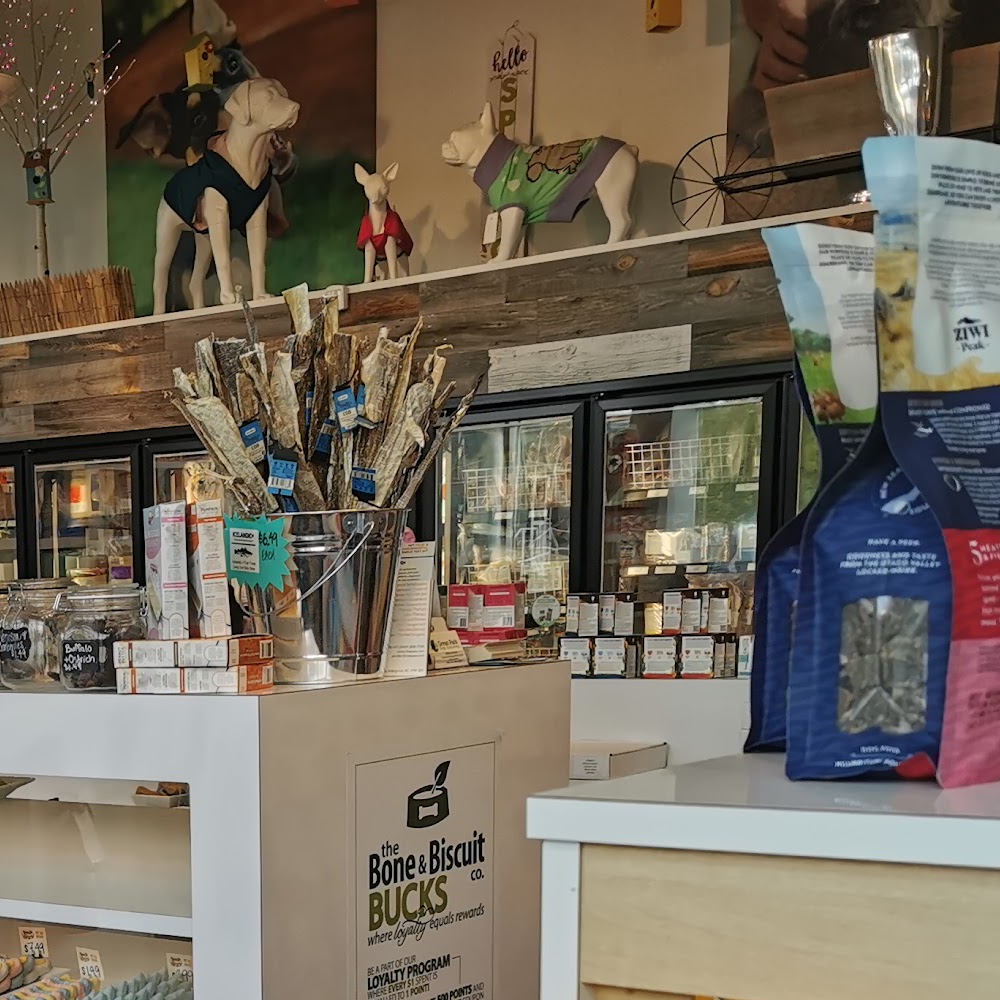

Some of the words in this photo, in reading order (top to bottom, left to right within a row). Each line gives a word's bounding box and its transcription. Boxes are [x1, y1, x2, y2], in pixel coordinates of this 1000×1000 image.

[492, 45, 529, 72] hello
[953, 324, 989, 342] ZIWI
[65, 643, 92, 653] Buffalo
[369, 853, 415, 889] Bone
[419, 854, 426, 874] &
[429, 830, 485, 875] Biscuit
[381, 841, 399, 857] the
[369, 875, 447, 931] BUCKS
[367, 930, 392, 946] where
[394, 913, 431, 946] loyalty
[429, 911, 454, 930] equals
[455, 902, 485, 922] rewards
[367, 967, 374, 976] BE
[380, 961, 394, 972] PART
[395, 958, 403, 967] OF
[404, 955, 416, 965] OUR
[367, 967, 405, 990] LOYALTY
[407, 954, 450, 979] PROGRAM
[367, 988, 387, 999] WHERE
[388, 982, 406, 993] EVERY
[407, 979, 414, 988] $1
[415, 974, 430, 985] SPENT
[431, 971, 438, 979] IS
[397, 992, 405, 1000] TO
[450, 984, 472, 1000] POINTS
[473, 982, 484, 992] AND
